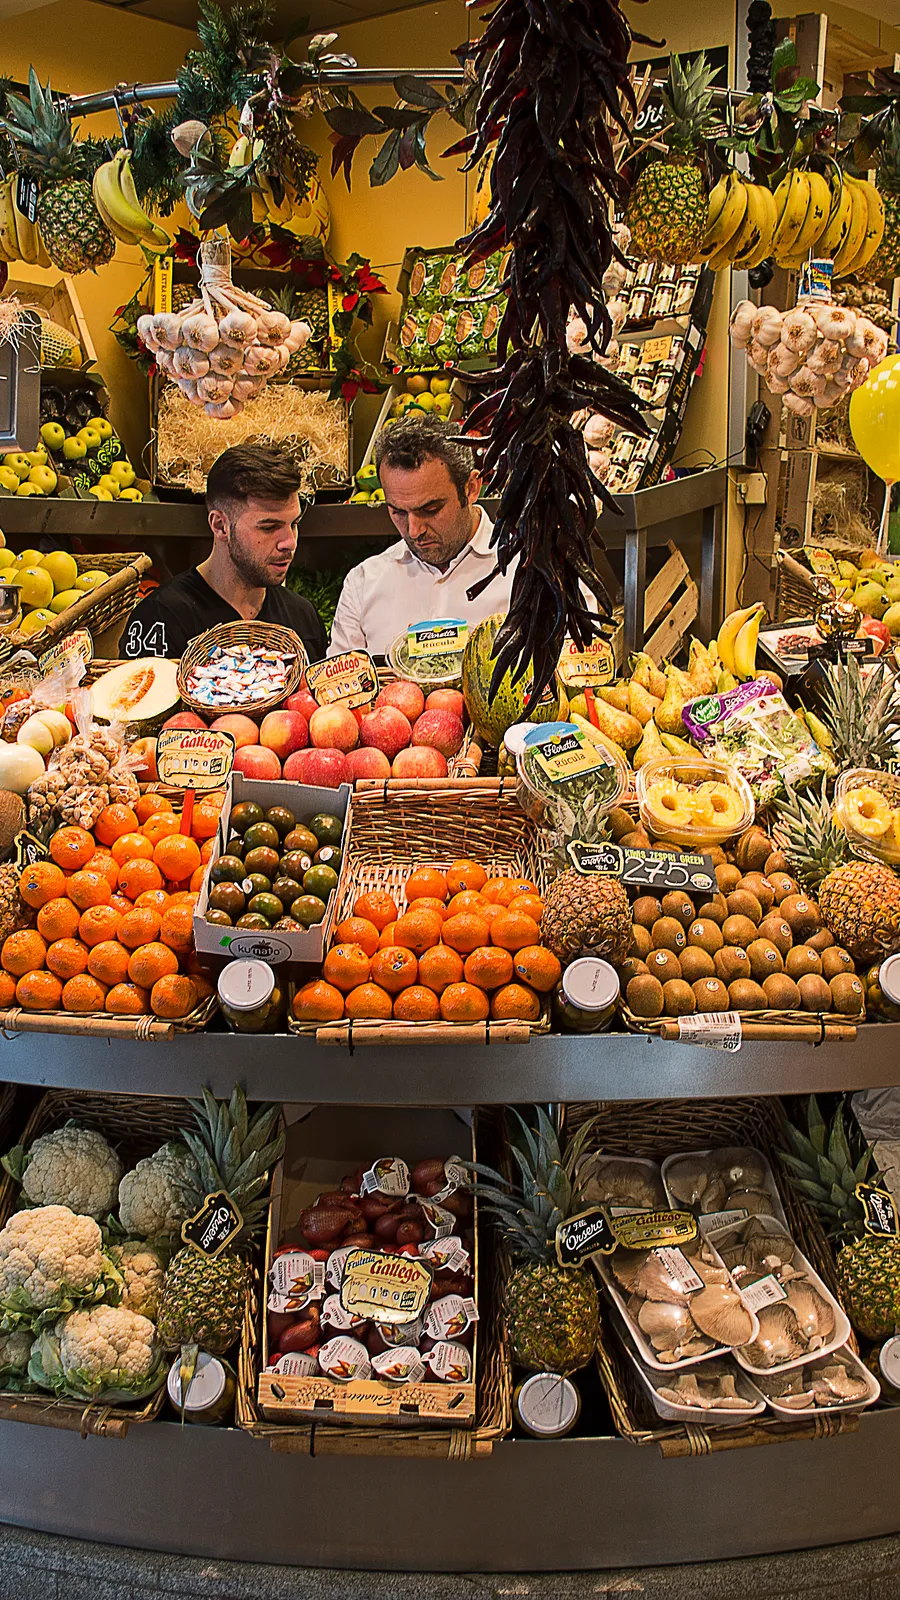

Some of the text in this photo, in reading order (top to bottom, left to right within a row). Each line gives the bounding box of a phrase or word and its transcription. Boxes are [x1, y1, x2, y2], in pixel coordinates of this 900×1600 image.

[125, 620, 168, 657] 34
[418, 630, 456, 641] Florette
[325, 657, 360, 678] Gallego
[180, 735, 225, 753] Gallego
[543, 739, 578, 757] Florette
[554, 752, 586, 768] Rúcula
[649, 851, 676, 862] ZESPRI
[679, 854, 704, 865] GREEN
[237, 944, 280, 957] kumato
[202, 1207, 230, 1249] Orsero
[635, 1213, 682, 1226] Gallego
[565, 1218, 604, 1251] Orsero
[369, 1259, 421, 1284] Gallego
